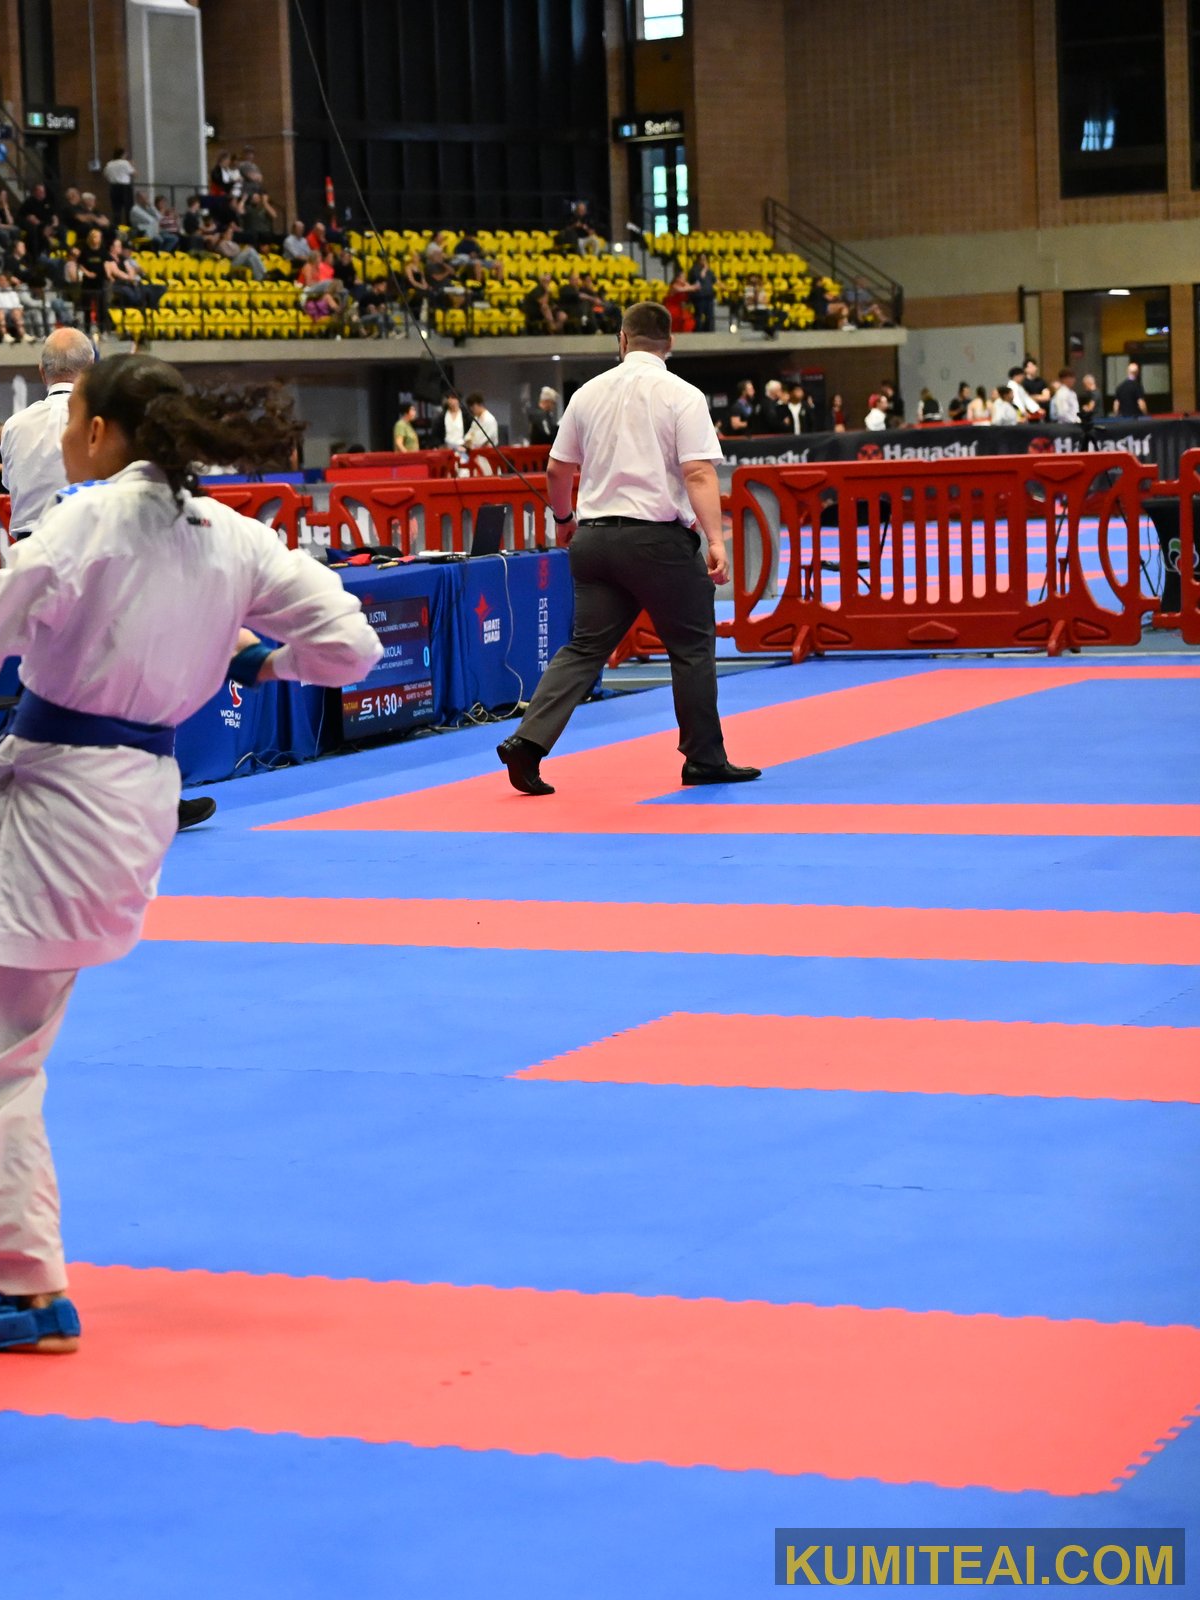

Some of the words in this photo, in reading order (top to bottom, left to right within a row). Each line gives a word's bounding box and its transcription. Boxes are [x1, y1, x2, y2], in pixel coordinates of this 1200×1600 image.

[46, 112, 75, 130] Sortie
[644, 119, 680, 136] Sortie
[883, 441, 979, 463] Hayashi
[423, 646, 430, 668] 0
